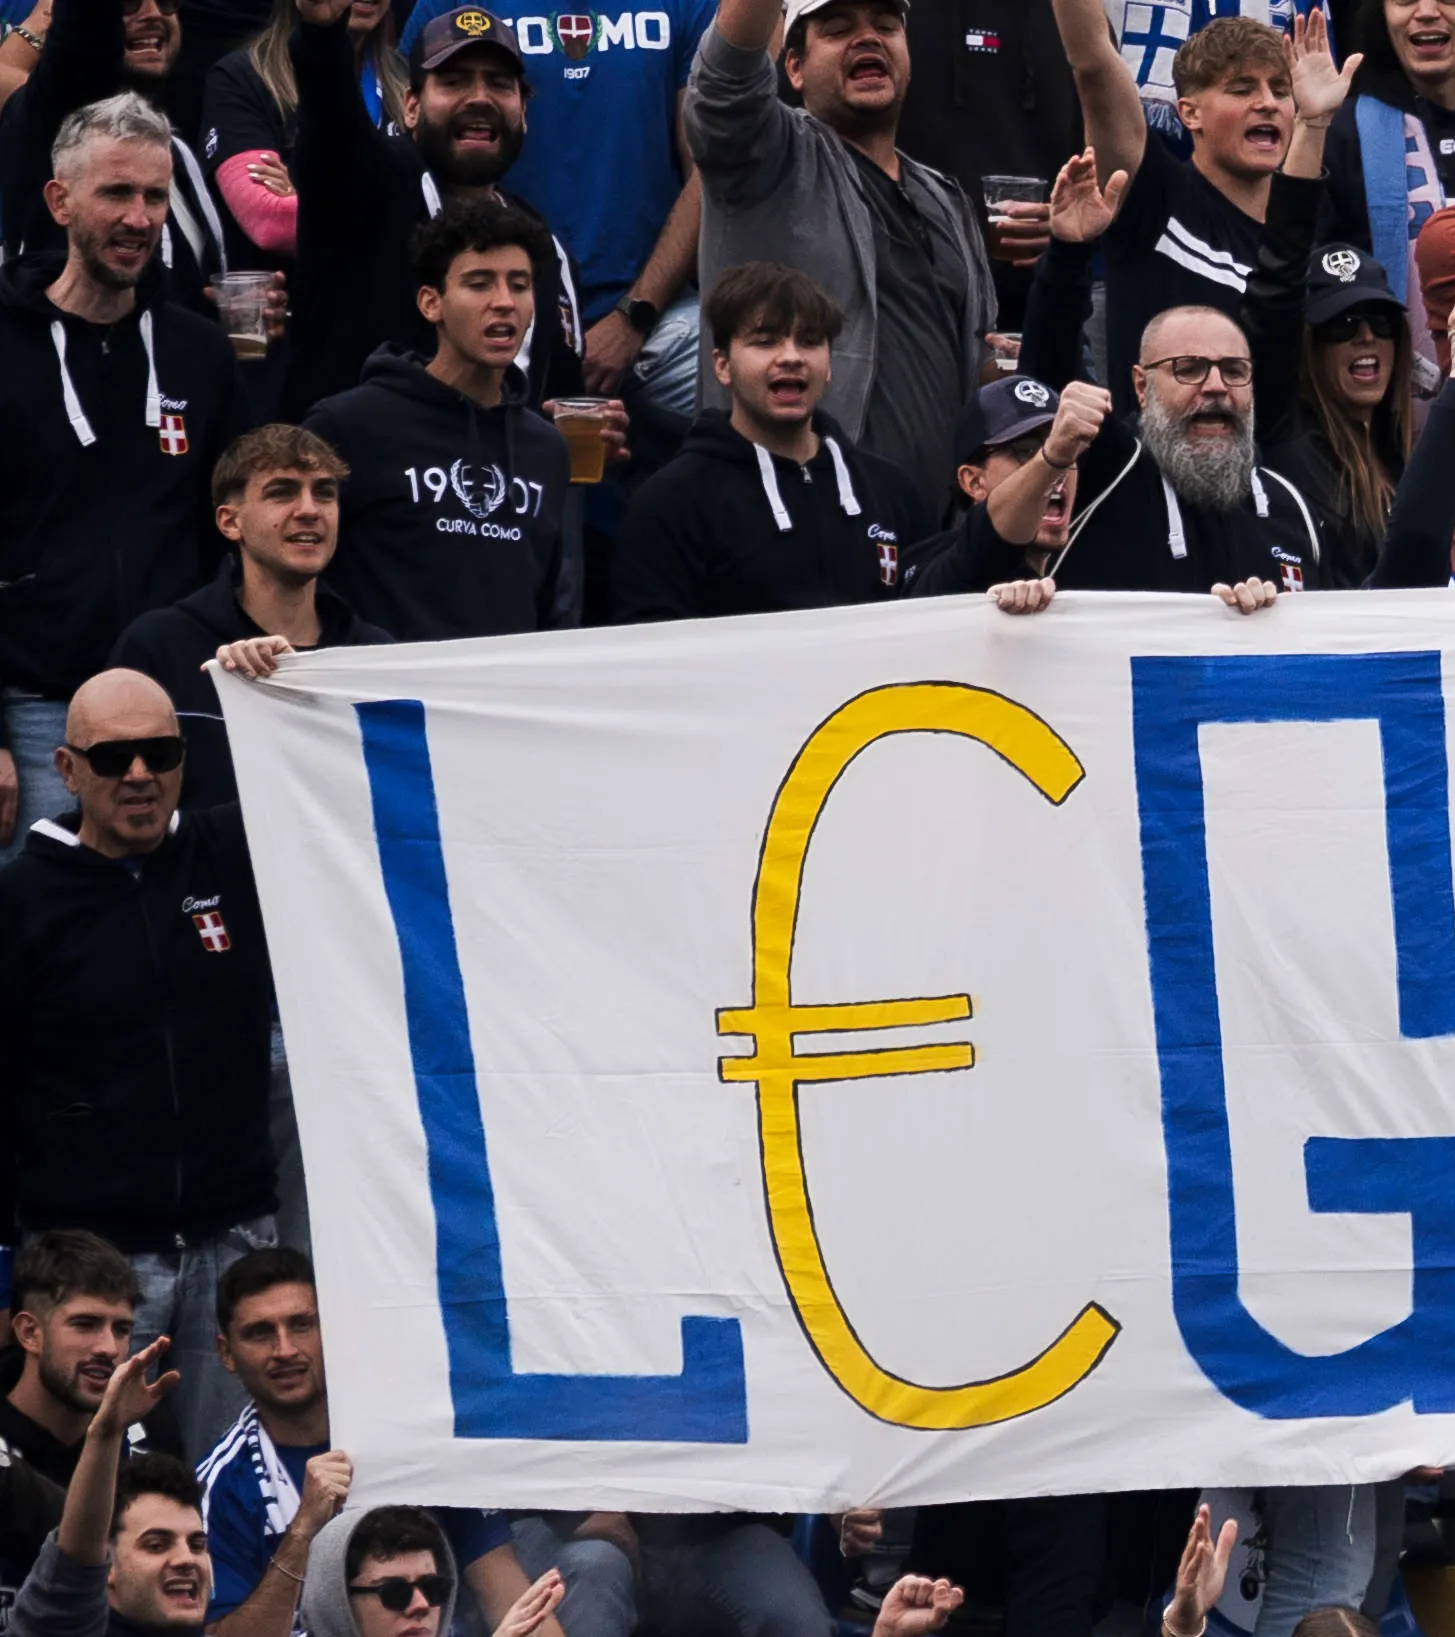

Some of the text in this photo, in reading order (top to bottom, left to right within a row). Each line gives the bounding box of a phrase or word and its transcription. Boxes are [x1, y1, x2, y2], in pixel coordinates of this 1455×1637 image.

[502, 12, 670, 54] OMO
[563, 66, 591, 80] 1907
[436, 518, 522, 542] CURVA COMO
[181, 895, 222, 913] Como
